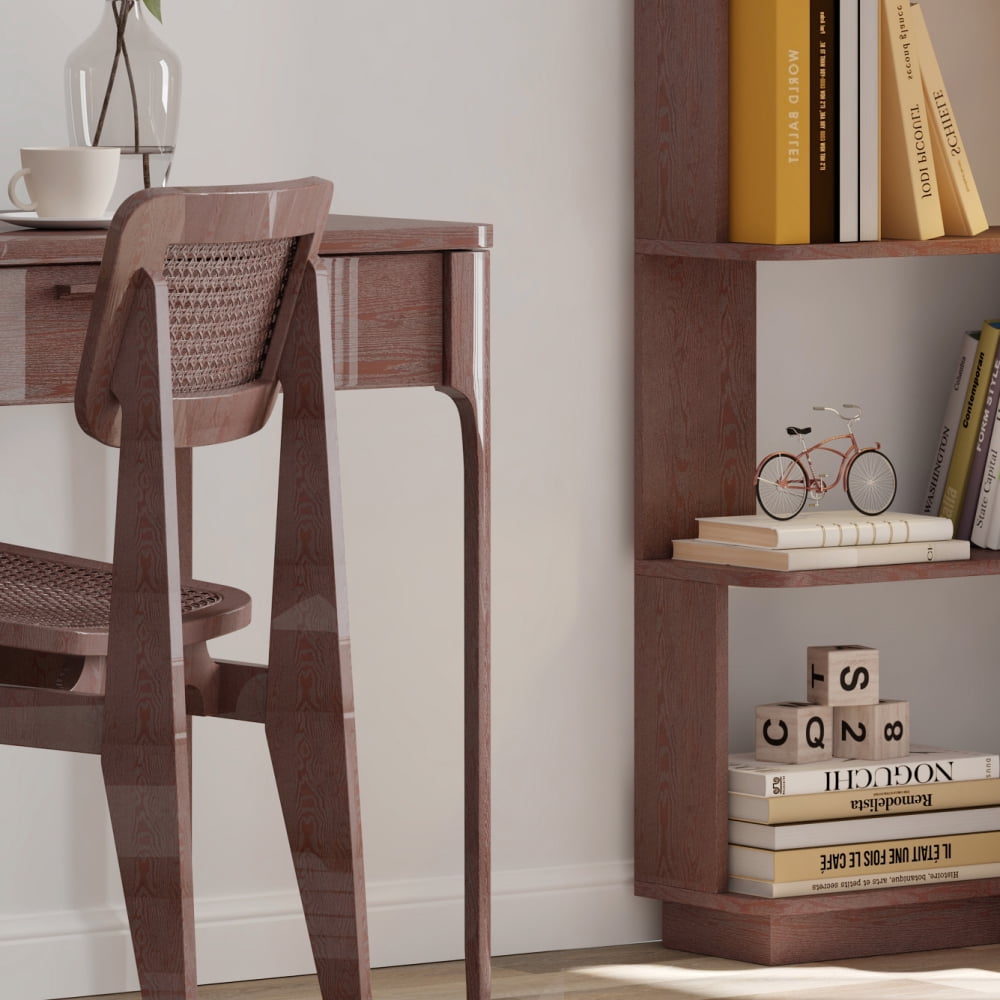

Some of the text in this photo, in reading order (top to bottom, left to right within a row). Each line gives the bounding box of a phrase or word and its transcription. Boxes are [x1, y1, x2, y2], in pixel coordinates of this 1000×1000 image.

[962, 351, 985, 428] Contemporan
[976, 359, 1000, 452] FORM STYLE
[923, 426, 950, 514] WASHINGTON
[975, 497, 990, 528] State
[983, 449, 998, 494] Capital
[811, 664, 869, 691] T S
[763, 719, 788, 746] C
[805, 716, 825, 749] Q
[884, 720, 903, 741] 8
[824, 761, 954, 792] NOGUCHI
[850, 793, 933, 812] Remodelista
[820, 843, 951, 874] IL ÉTAIT UNE FOIS LE CAFÉ
[812, 882, 839, 891] secrets
[840, 878, 862, 889] petits
[872, 878, 888, 886] arts
